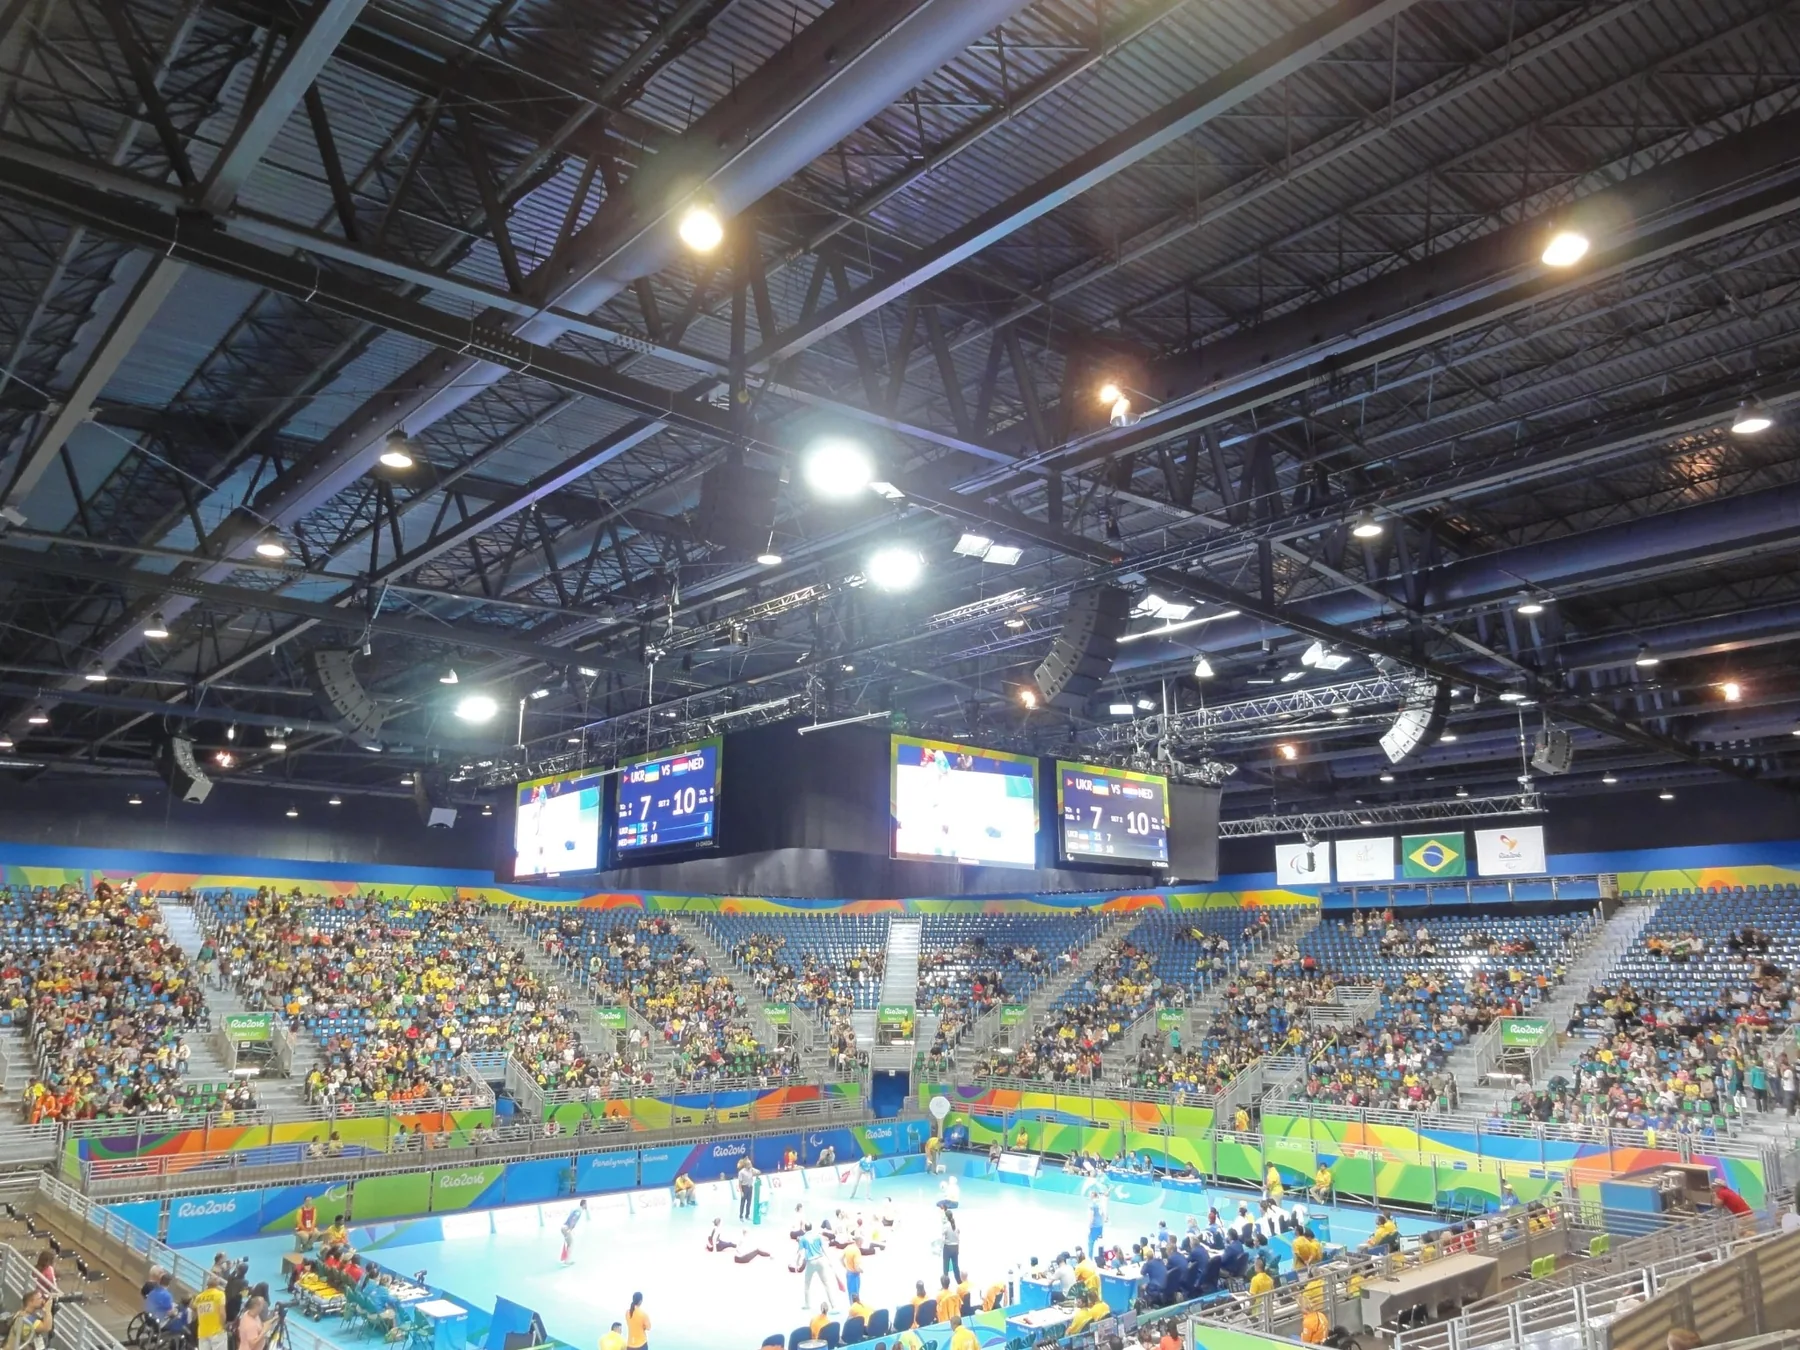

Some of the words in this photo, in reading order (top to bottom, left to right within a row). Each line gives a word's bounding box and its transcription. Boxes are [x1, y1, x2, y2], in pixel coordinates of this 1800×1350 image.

[630, 769, 645, 783] UKR
[661, 764, 671, 776] VS
[688, 757, 704, 771] NED
[1075, 778, 1092, 791] UKR
[1110, 784, 1121, 795] VS
[1137, 787, 1153, 799] NED
[640, 795, 652, 821] 7
[672, 787, 696, 816] 10
[1090, 806, 1102, 829] 7
[1127, 811, 1149, 836] 10
[712, 1143, 746, 1158] Rio2016
[592, 1157, 635, 1169] Paralympic
[440, 1171, 485, 1188] Rio2016
[178, 1198, 237, 1218] Rio2016
